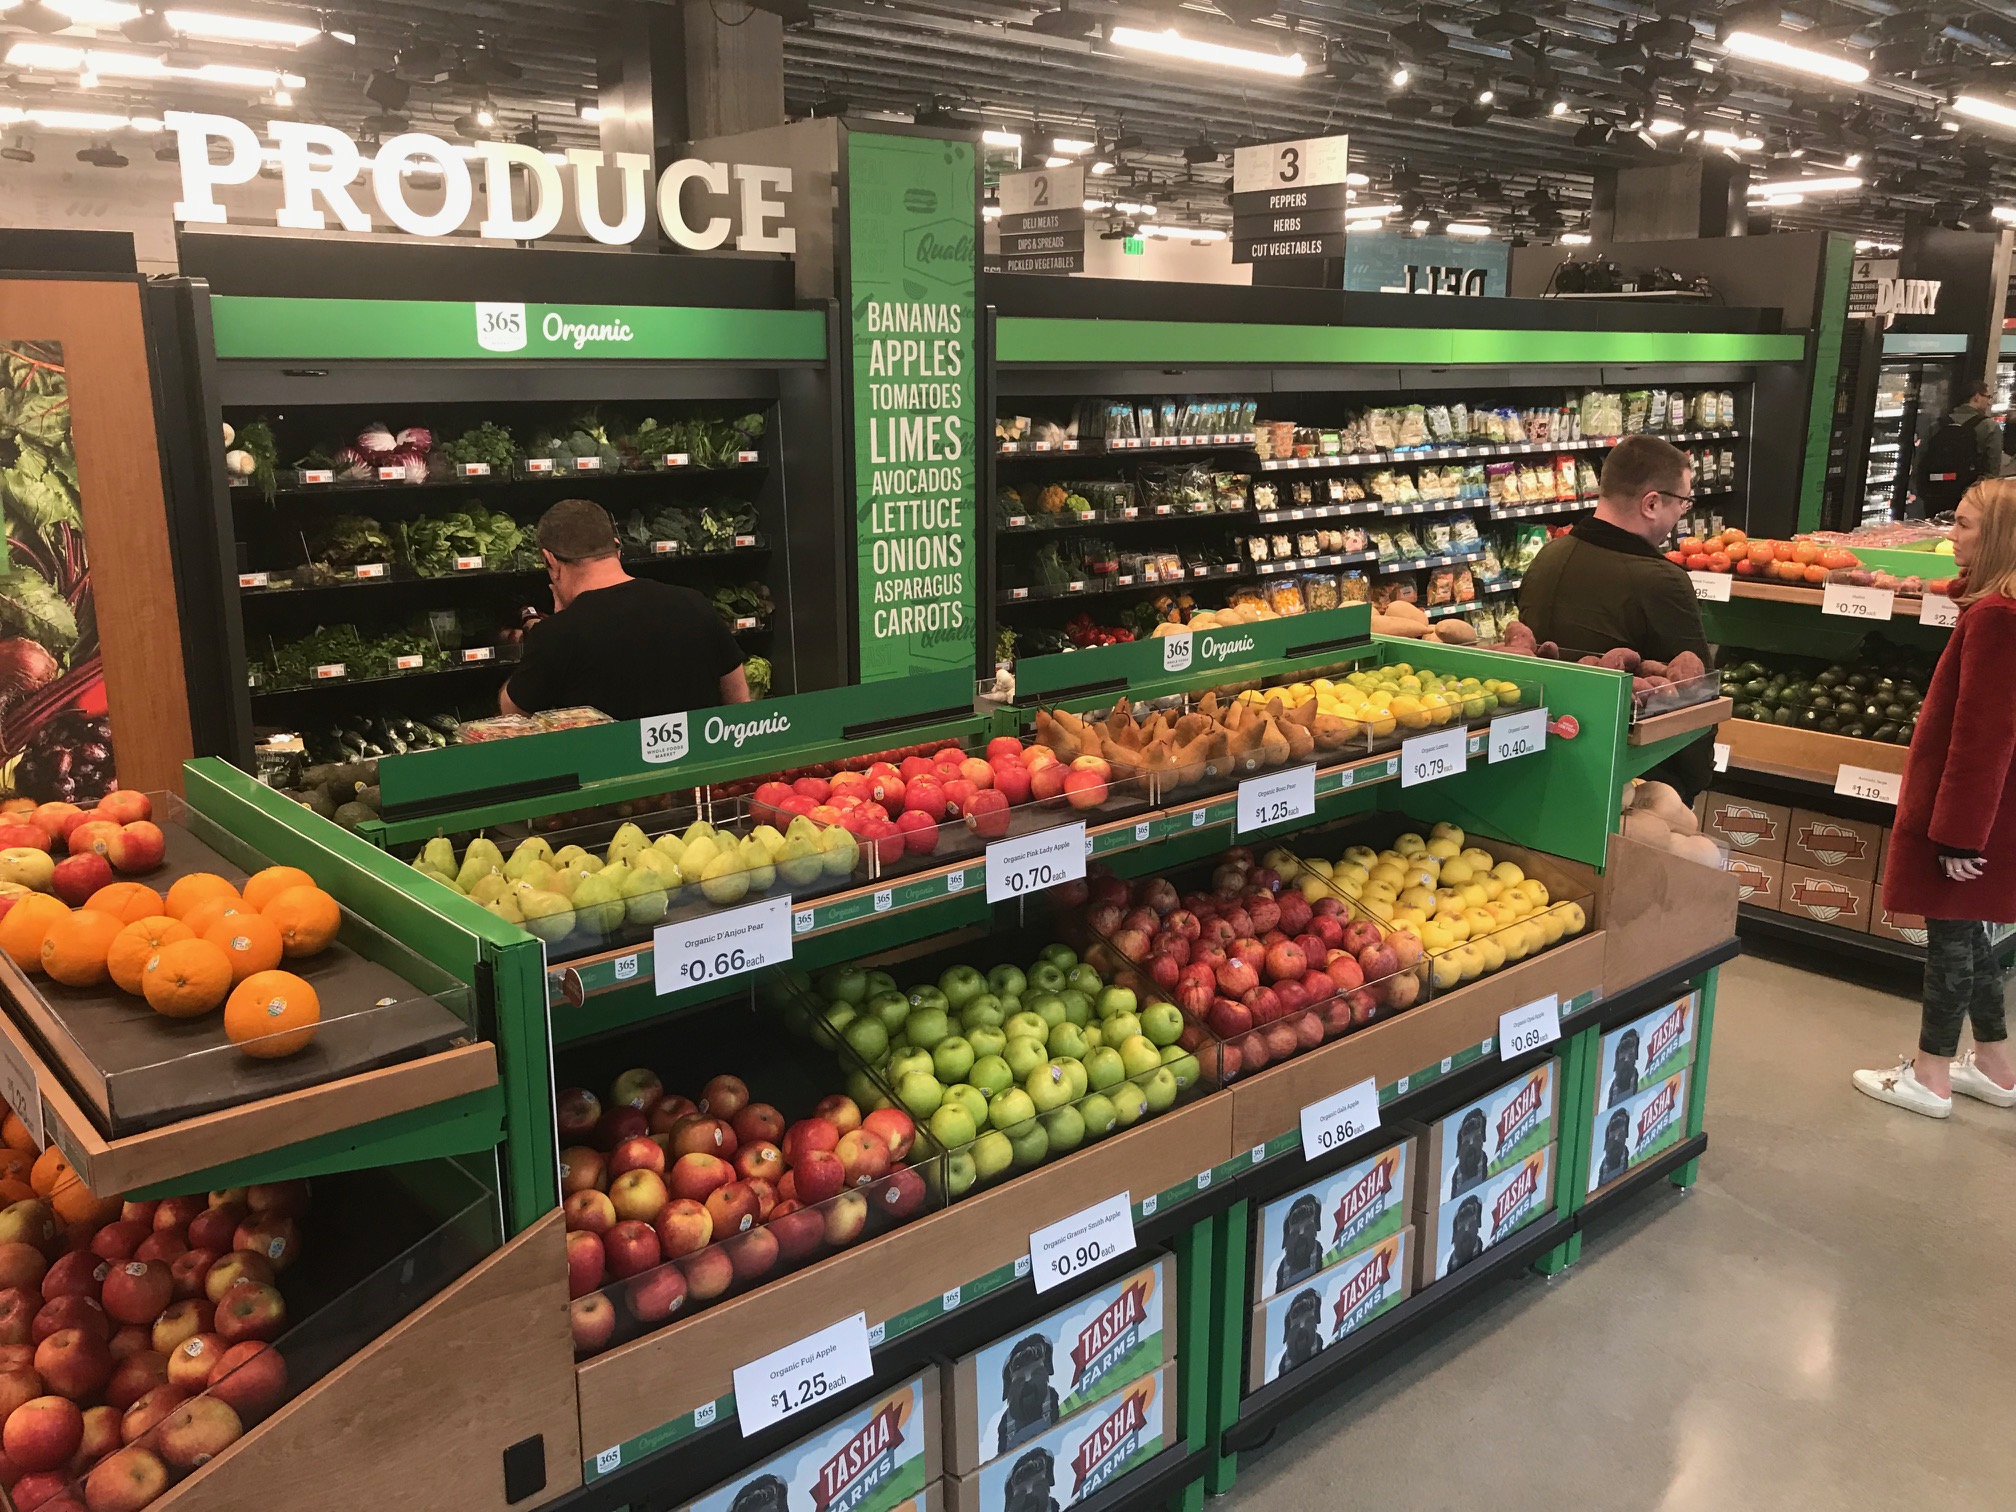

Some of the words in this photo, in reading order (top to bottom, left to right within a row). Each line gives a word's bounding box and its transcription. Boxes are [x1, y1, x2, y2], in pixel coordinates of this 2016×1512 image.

[1280, 147, 1299, 182] 3
[164, 110, 796, 253] PRODUCE
[1034, 176, 1048, 206] 2
[1269, 193, 1307, 209] PEPPERS
[1022, 217, 1038, 230] DELI
[1037, 215, 1059, 228] MEATS
[1273, 217, 1301, 232] HERBS
[1018, 238, 1032, 250] DIPS
[1038, 236, 1064, 249] SPREADS
[1251, 244, 1268, 257] CUT
[1269, 240, 1322, 256] VEGETABLES
[1008, 260, 1033, 271] PICKLED
[1034, 257, 1074, 270] VEGETABLES
[1857, 262, 1870, 278] 4
[1875, 278, 1941, 315] DAIRY
[482, 311, 520, 333] 365
[542, 312, 634, 350] Organic
[868, 301, 961, 333] BANANAS
[869, 339, 962, 377] APPLES
[869, 383, 961, 410] TOMATOES
[870, 415, 962, 464] LIMES
[872, 466, 962, 496] AVOCADOS
[872, 497, 962, 534] LETTUCE
[873, 533, 962, 575] ONIONS
[874, 572, 962, 604] ASPARAGUS
[874, 600, 963, 639] CARROTS
[1836, 602, 1867, 615] $0.79
[1167, 640, 1190, 659] 365
[1201, 634, 1255, 662] Organic
[646, 722, 683, 748] 365
[704, 711, 791, 748] Organic
[646, 747, 665, 755] WHOLE
[666, 744, 684, 752] FOODS
[655, 751, 676, 759] MARKET
[1498, 739, 1526, 758] $0.40
[1414, 759, 1444, 778] $0.79
[1257, 789, 1275, 797] Organic
[1852, 784, 1880, 799] $1.19
[1256, 801, 1288, 824] $1.25
[1137, 826, 1148, 835] 365
[1003, 853, 1026, 864] Organic
[1039, 846, 1053, 855] Lady
[1053, 841, 1070, 851] Apple
[949, 874, 963, 885] 365
[1004, 864, 1052, 892] $0.70
[1052, 869, 1067, 881] each
[876, 893, 890, 905] 365
[796, 913, 812, 926] 365
[684, 935, 716, 948] Organic
[716, 928, 747, 941] D'Anjou
[747, 922, 764, 932] Pear
[617, 958, 636, 973] 365
[680, 949, 746, 982] $0.66
[746, 953, 765, 968] each
[1511, 1029, 1540, 1051] $0.69
[1653, 1009, 1680, 1054] TASHA
[1649, 1037, 1678, 1075] FARMS
[1319, 1110, 1337, 1122] Organic
[1347, 1100, 1360, 1109] Apple
[1503, 1082, 1536, 1134] TASHA
[1643, 1086, 1671, 1132] TASHA
[1317, 1120, 1354, 1148] $0.86
[1500, 1116, 1535, 1158] FARMS
[1639, 1114, 1669, 1152] FARMS
[1253, 1146, 1263, 1156] 365
[1199, 1173, 1210, 1183] 365
[1145, 1199, 1156, 1209] 365
[1342, 1164, 1384, 1222] TASHA
[1498, 1167, 1531, 1219] TASHA
[1043, 1236, 1067, 1251] Organic
[1066, 1226, 1087, 1240] Granny
[1087, 1218, 1105, 1230] Smith
[1104, 1210, 1121, 1223] Apple
[1339, 1200, 1383, 1248] FARMS
[1496, 1198, 1530, 1242] FARMS
[1016, 1258, 1029, 1270] 365
[1051, 1241, 1100, 1276] $0.90
[1100, 1243, 1116, 1257] each
[1341, 1255, 1383, 1313] TASHA
[945, 1292, 959, 1305] 365
[1082, 1290, 1136, 1361] TASHA
[1340, 1288, 1382, 1339] FARMS
[868, 1326, 883, 1341] 365
[769, 1362, 800, 1380] Organic
[800, 1355, 815, 1367] Fuji
[815, 1344, 837, 1360] Apple
[1082, 1330, 1136, 1391] FARMS
[770, 1372, 828, 1413] $1.25
[828, 1374, 847, 1391] each
[696, 1405, 714, 1421] 365
[1082, 1399, 1136, 1470] TASHA
[599, 1450, 618, 1467] 365
[824, 1413, 890, 1497] TASHA
[1082, 1439, 1136, 1499] FARMS
[830, 1457, 891, 1512] ARMS
